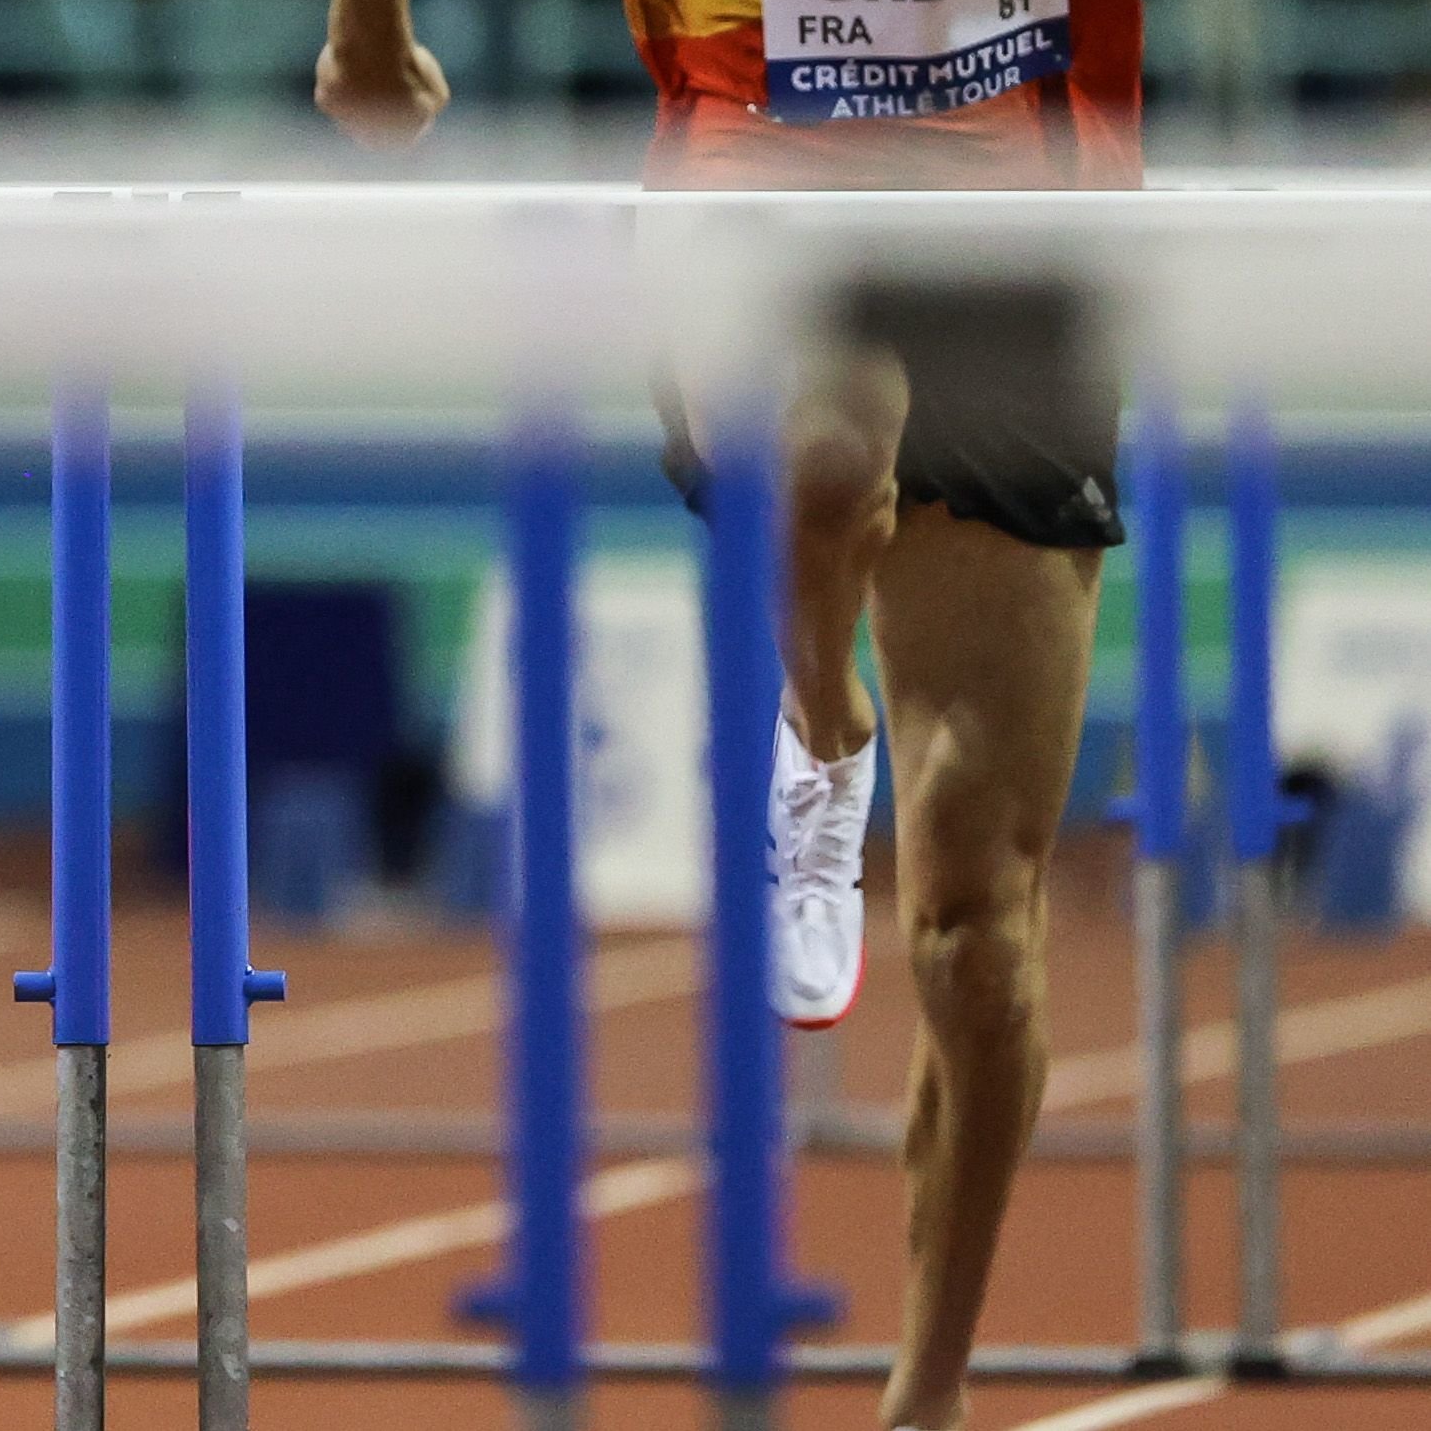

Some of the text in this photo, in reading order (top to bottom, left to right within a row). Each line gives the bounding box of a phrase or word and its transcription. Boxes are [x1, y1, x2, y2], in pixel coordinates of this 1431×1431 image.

[798, 16, 873, 44] FRA
[791, 28, 1053, 91] CRÉDIT MUTUEL
[830, 66, 1021, 118] ATHLÉ TOUR
